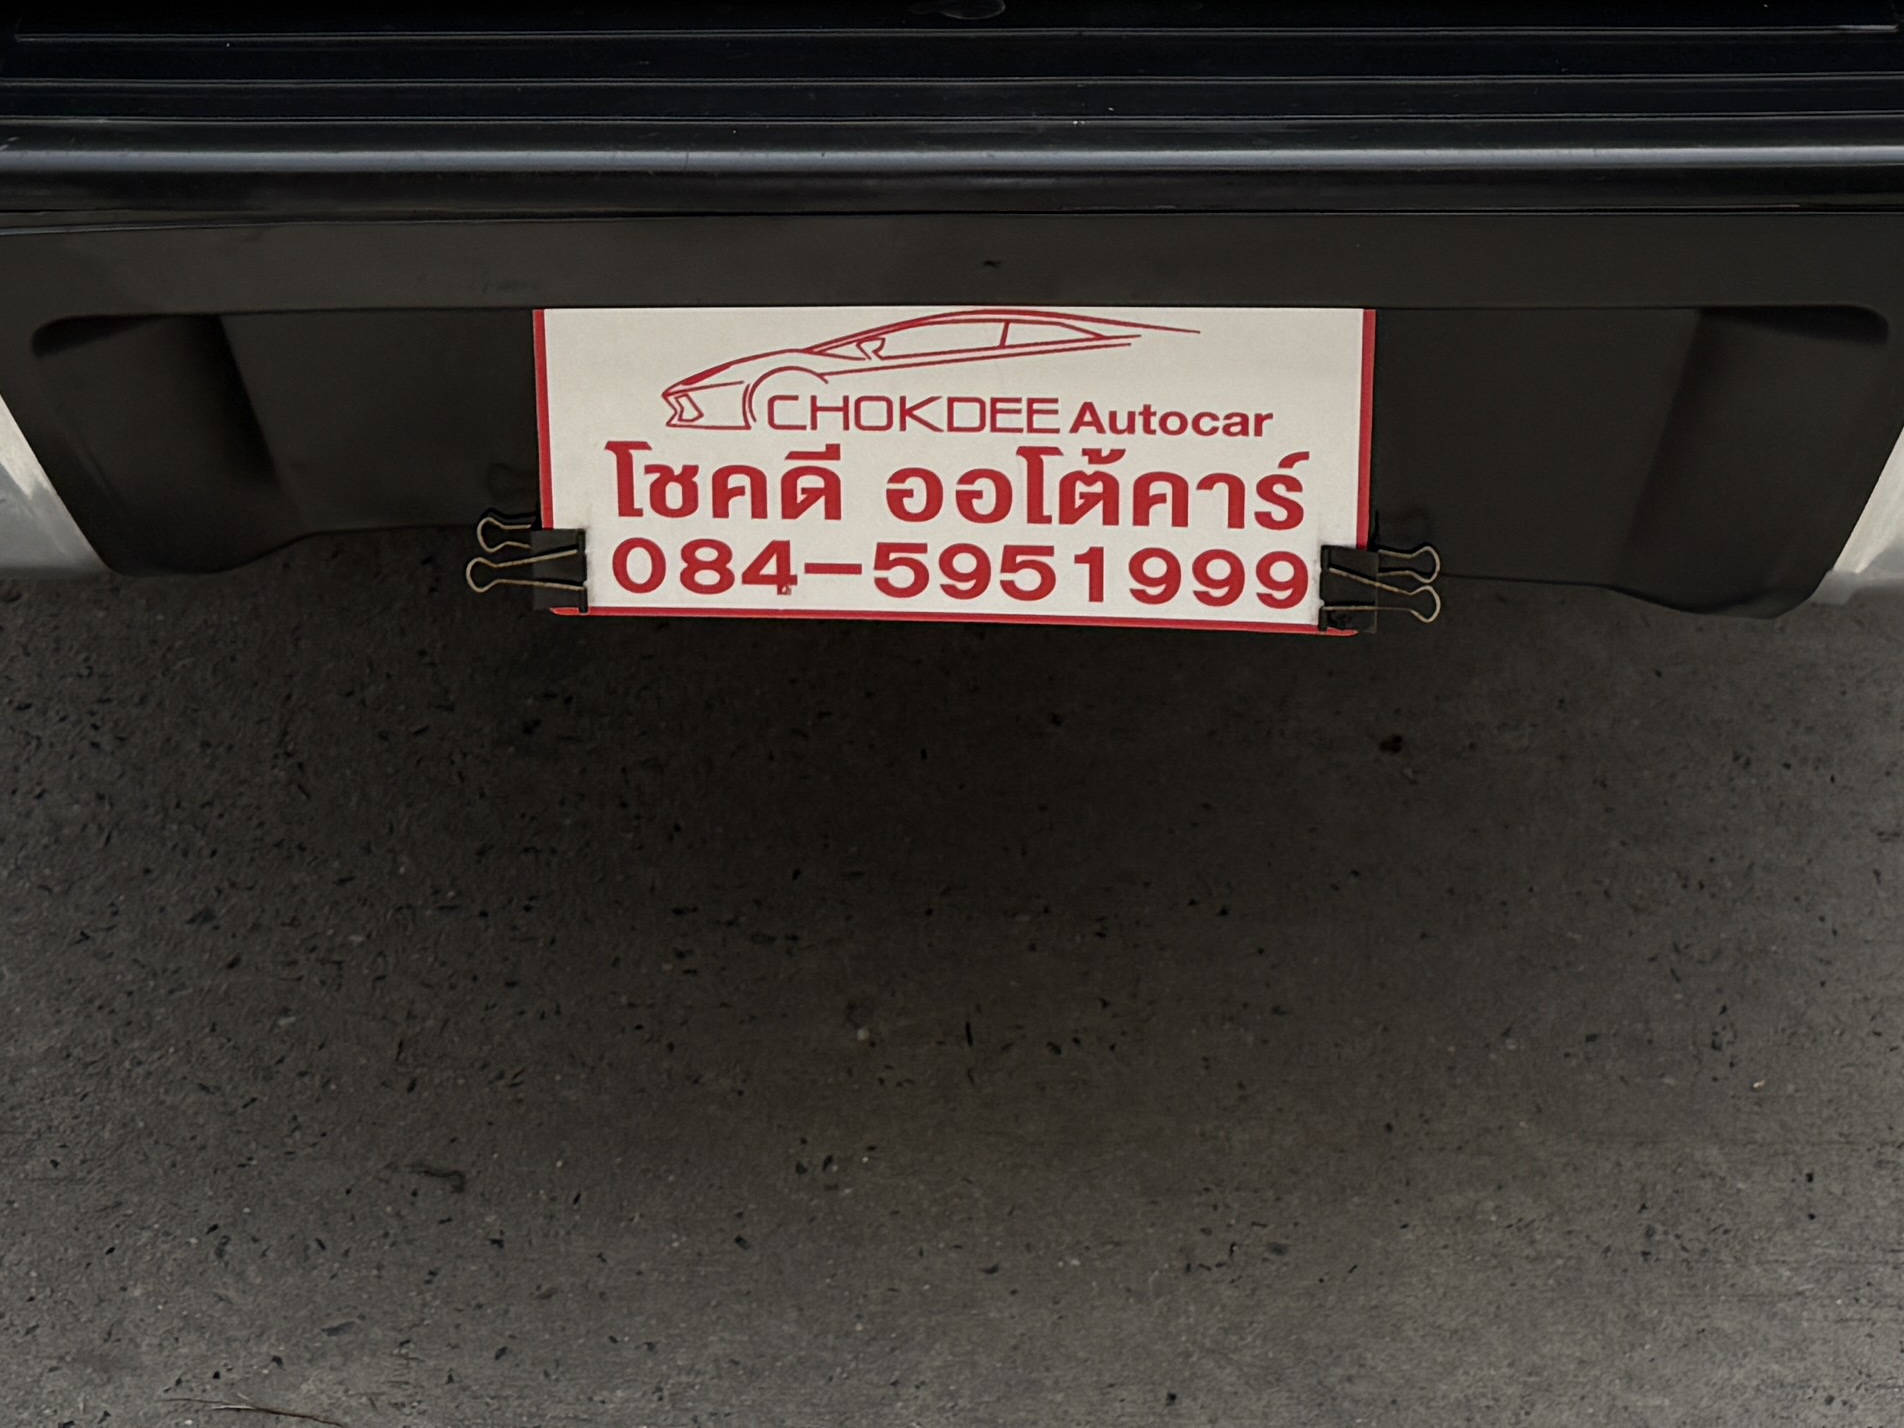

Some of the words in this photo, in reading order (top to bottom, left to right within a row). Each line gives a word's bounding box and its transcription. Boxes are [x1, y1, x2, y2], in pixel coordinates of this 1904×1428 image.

[765, 395, 1062, 435] CHOKDEE
[1069, 398, 1274, 439] Autocar
[605, 440, 848, 521] โชคดี
[885, 446, 1312, 532] ออโต้คาร์
[610, 538, 1309, 610] 084-5951999
